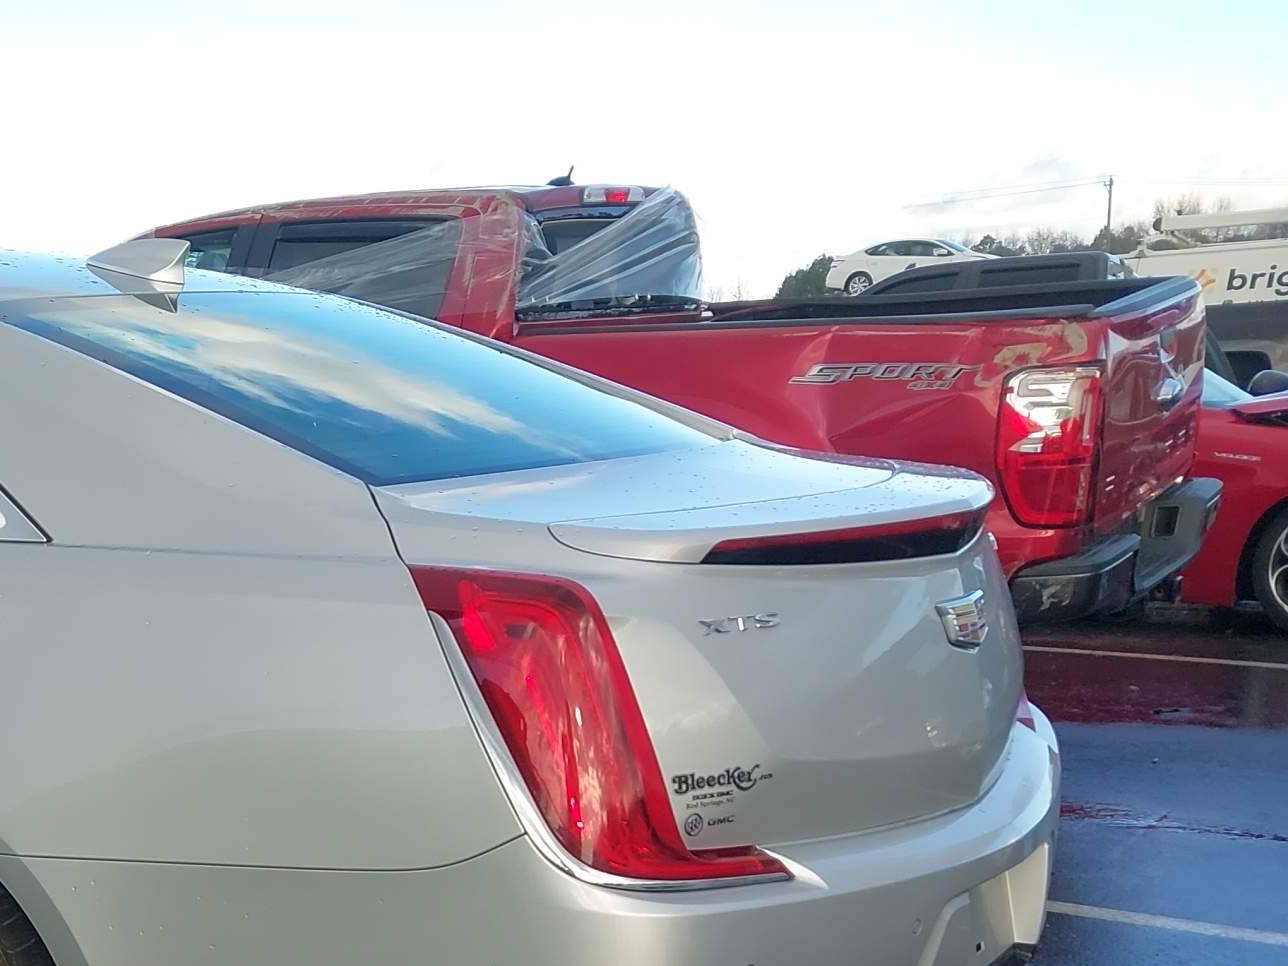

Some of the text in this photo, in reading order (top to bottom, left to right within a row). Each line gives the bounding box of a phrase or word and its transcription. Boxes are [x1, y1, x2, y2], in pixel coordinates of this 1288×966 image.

[788, 363, 984, 385] SPORT
[697, 612, 780, 637] XTS
[707, 815, 736, 827] GMC
